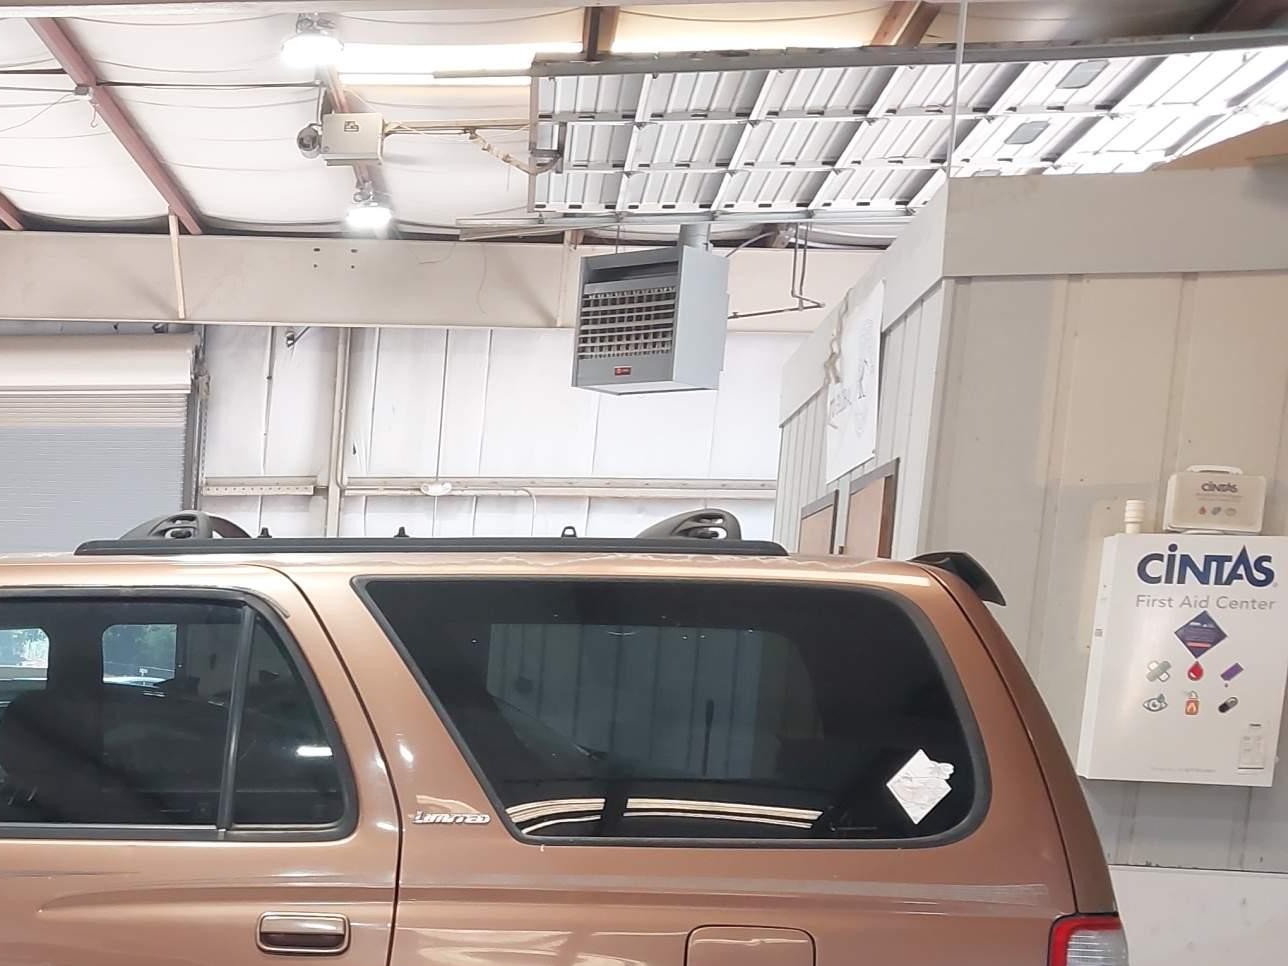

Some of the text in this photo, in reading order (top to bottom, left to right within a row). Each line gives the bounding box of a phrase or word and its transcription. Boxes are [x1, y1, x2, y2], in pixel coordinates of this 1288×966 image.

[1135, 594, 1276, 610] First Aid Center
